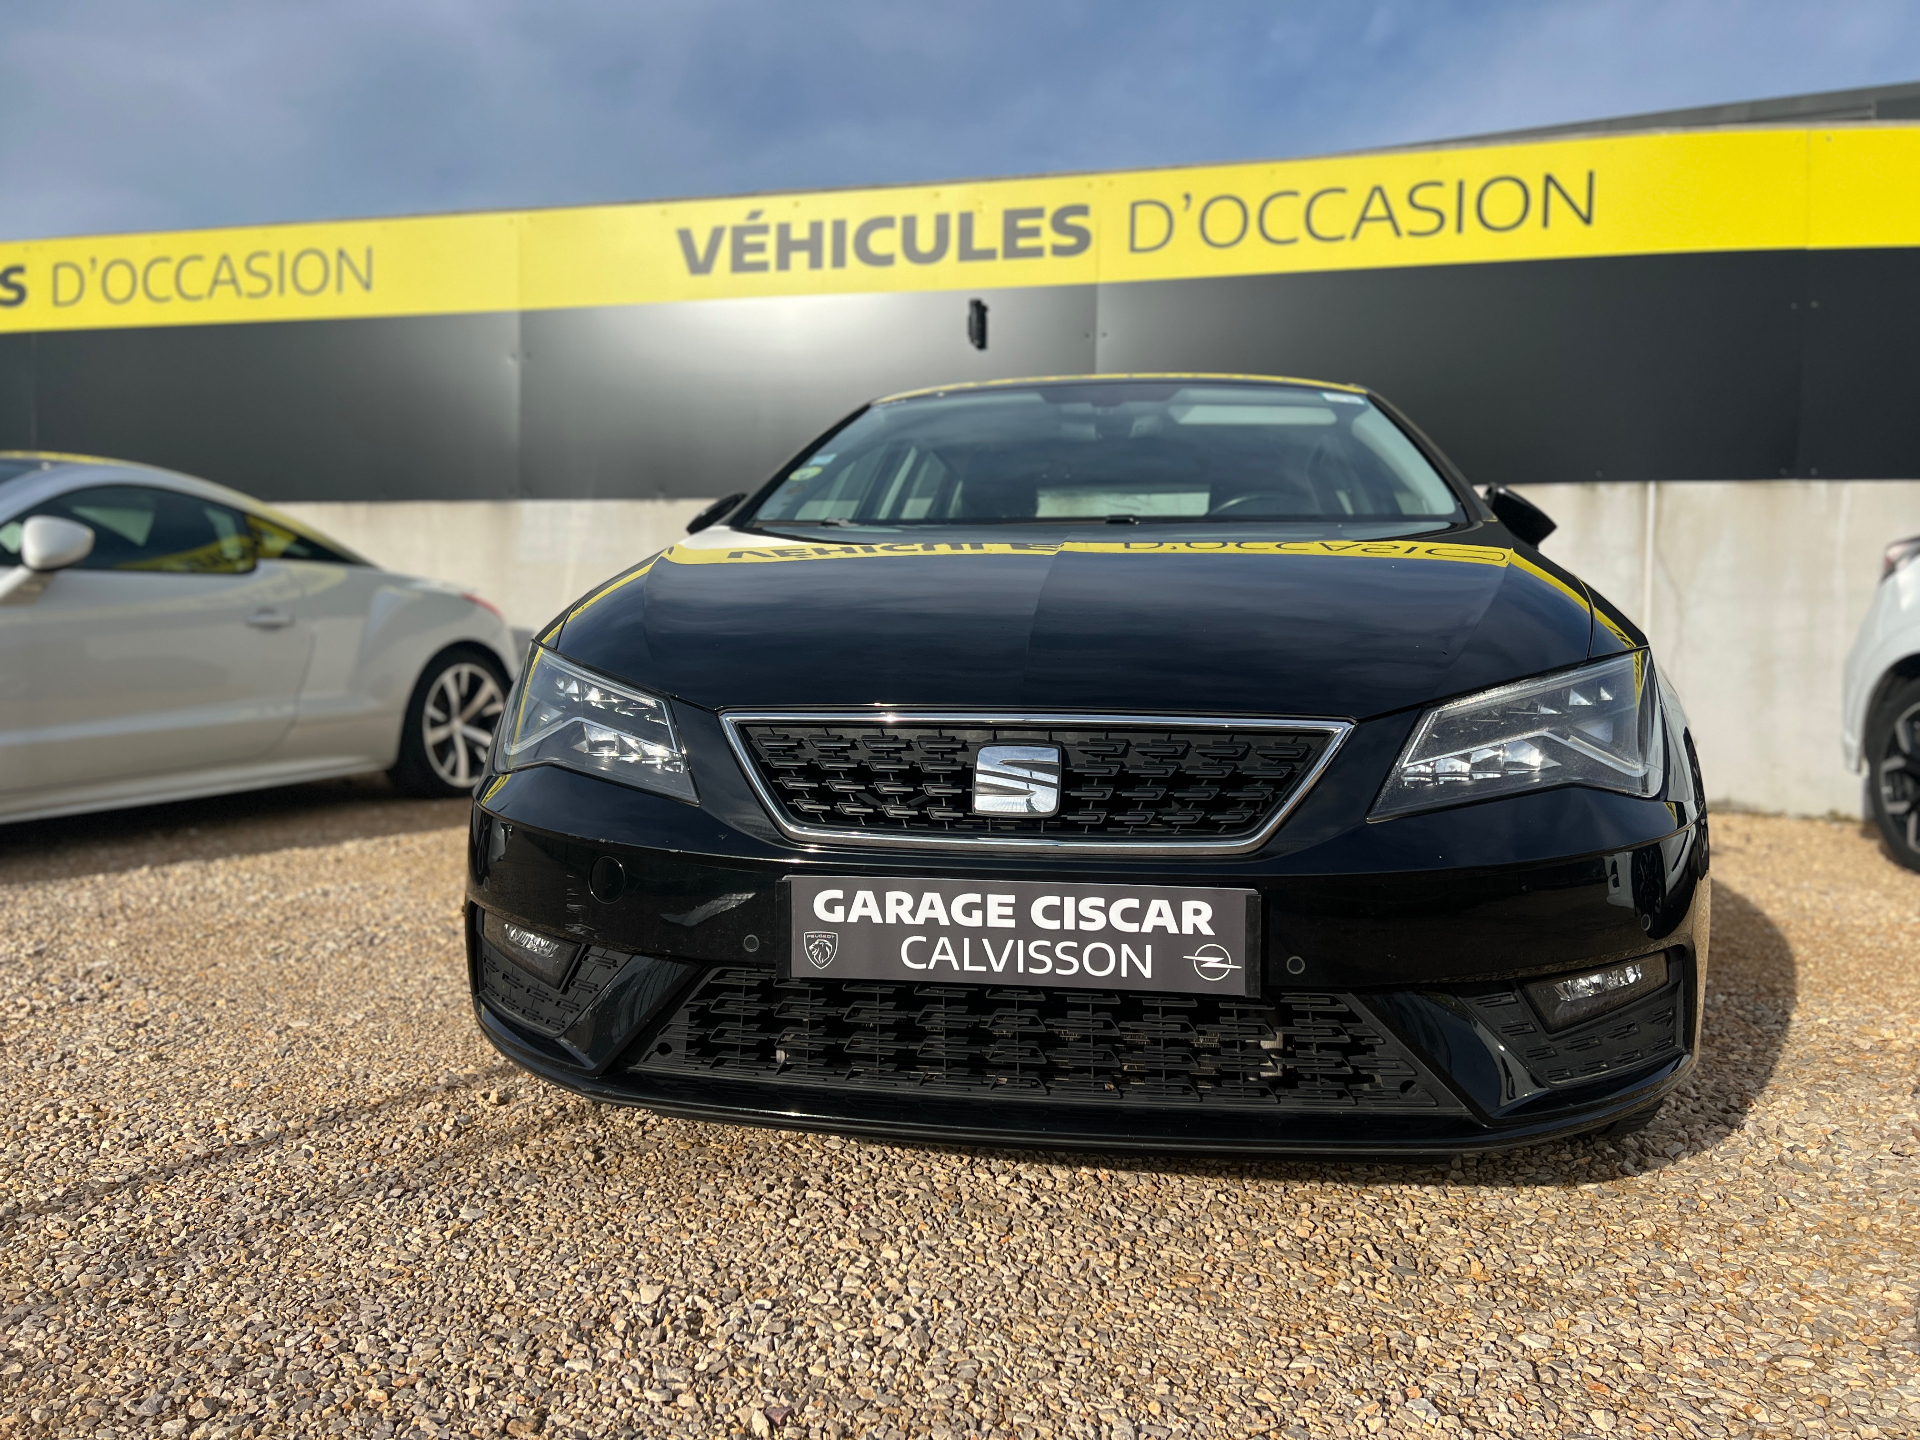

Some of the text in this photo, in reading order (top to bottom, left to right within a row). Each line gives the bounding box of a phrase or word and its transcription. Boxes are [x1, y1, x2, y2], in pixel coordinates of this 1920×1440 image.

[676, 169, 1596, 276] VÉHICULES D'OCCASION
[52, 245, 374, 307] D'OCCASION
[813, 889, 1215, 936] GARAGE CISCAR
[900, 935, 1152, 979] CALVISSON
